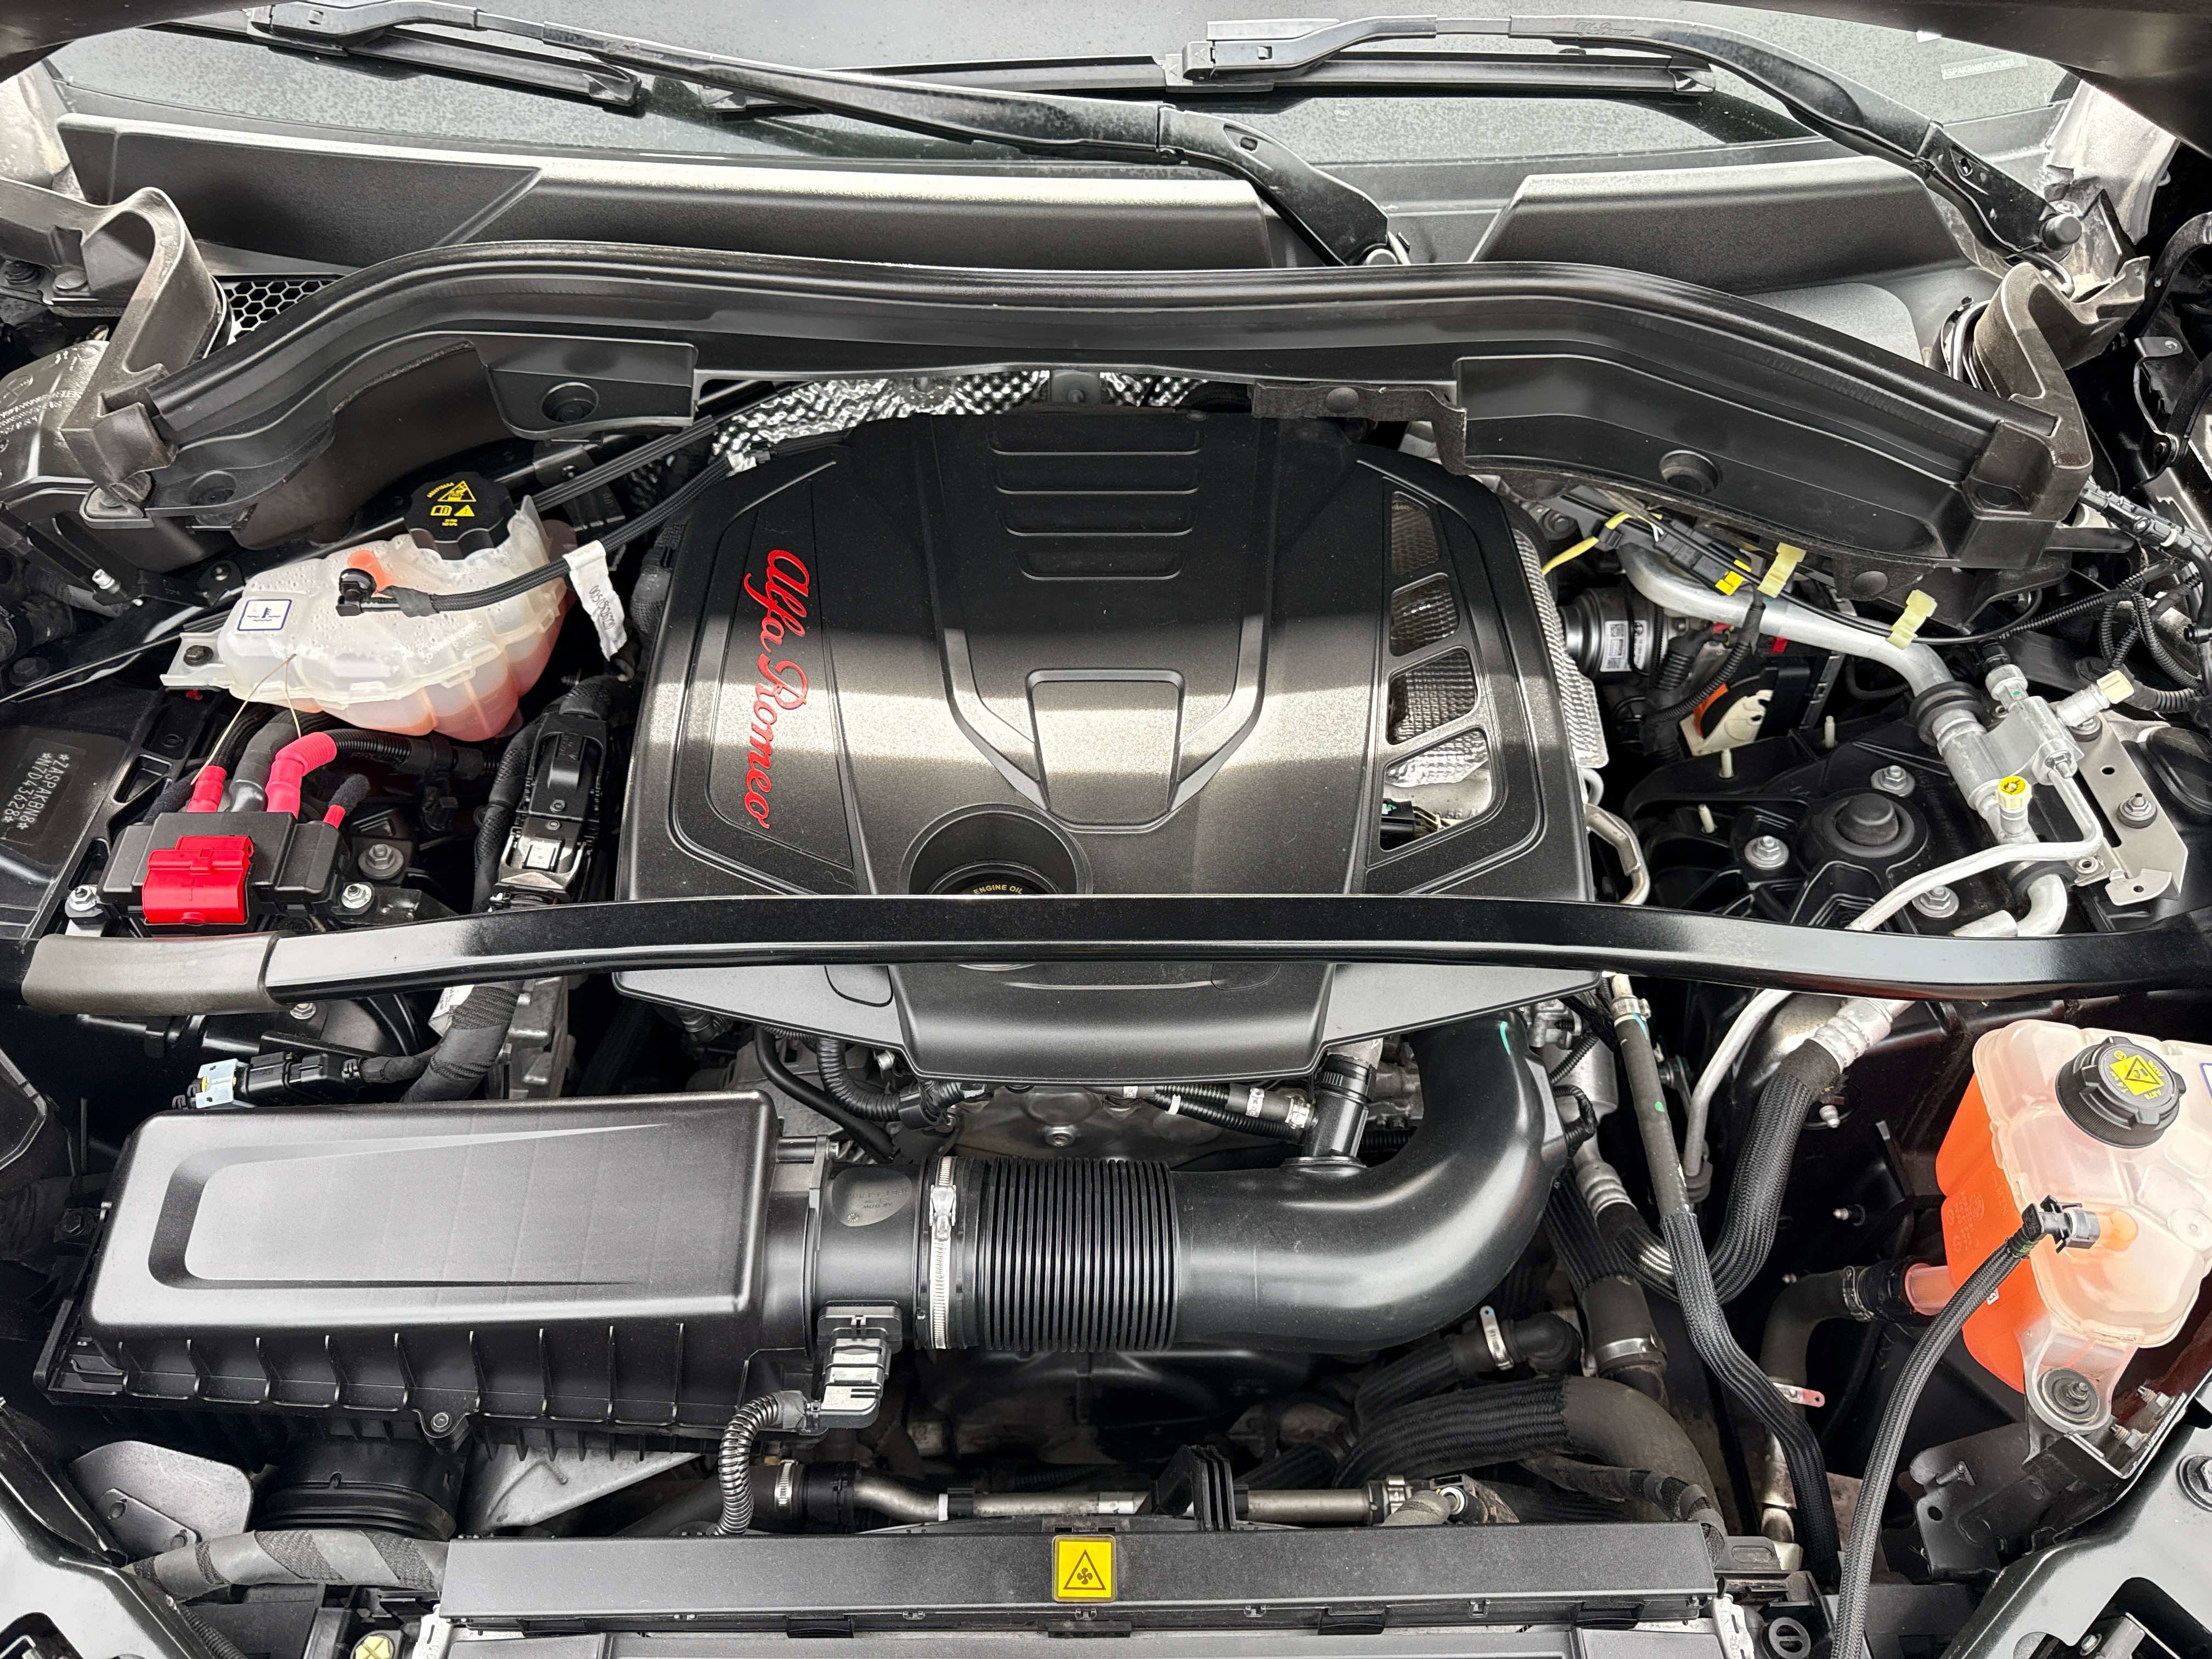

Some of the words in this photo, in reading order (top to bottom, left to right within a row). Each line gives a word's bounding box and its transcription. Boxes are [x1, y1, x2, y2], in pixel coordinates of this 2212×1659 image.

[744, 549, 810, 654] Alfa
[743, 653, 809, 830] Romeo
[973, 884, 1007, 895] ENGINE
[1009, 885, 1023, 895] OIL
